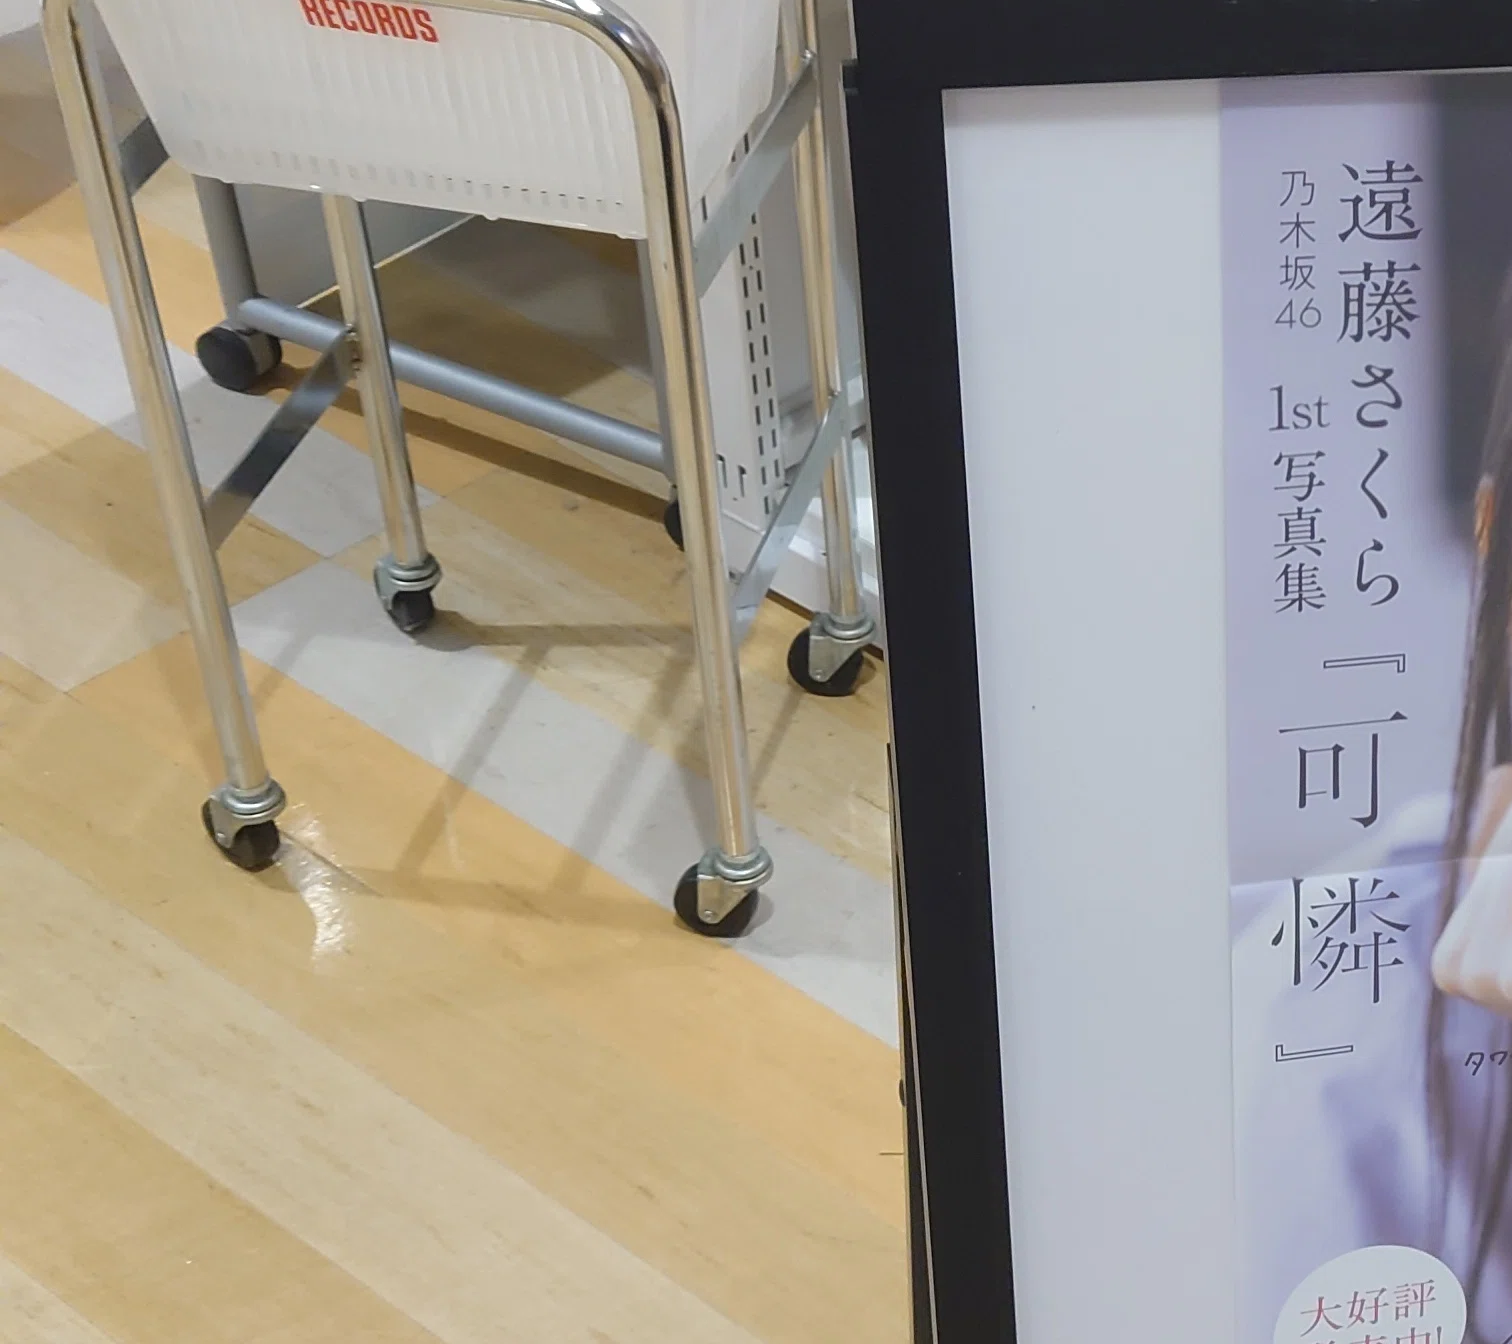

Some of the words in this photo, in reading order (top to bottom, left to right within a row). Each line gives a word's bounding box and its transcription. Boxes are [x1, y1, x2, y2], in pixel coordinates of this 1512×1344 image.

[1275, 170, 1322, 330] 乃木坂46
[1337, 159, 1424, 607] 遠藤さくら
[1270, 653, 1411, 1063] 『可憐』
[1299, 1278, 1437, 1339] 大好評
